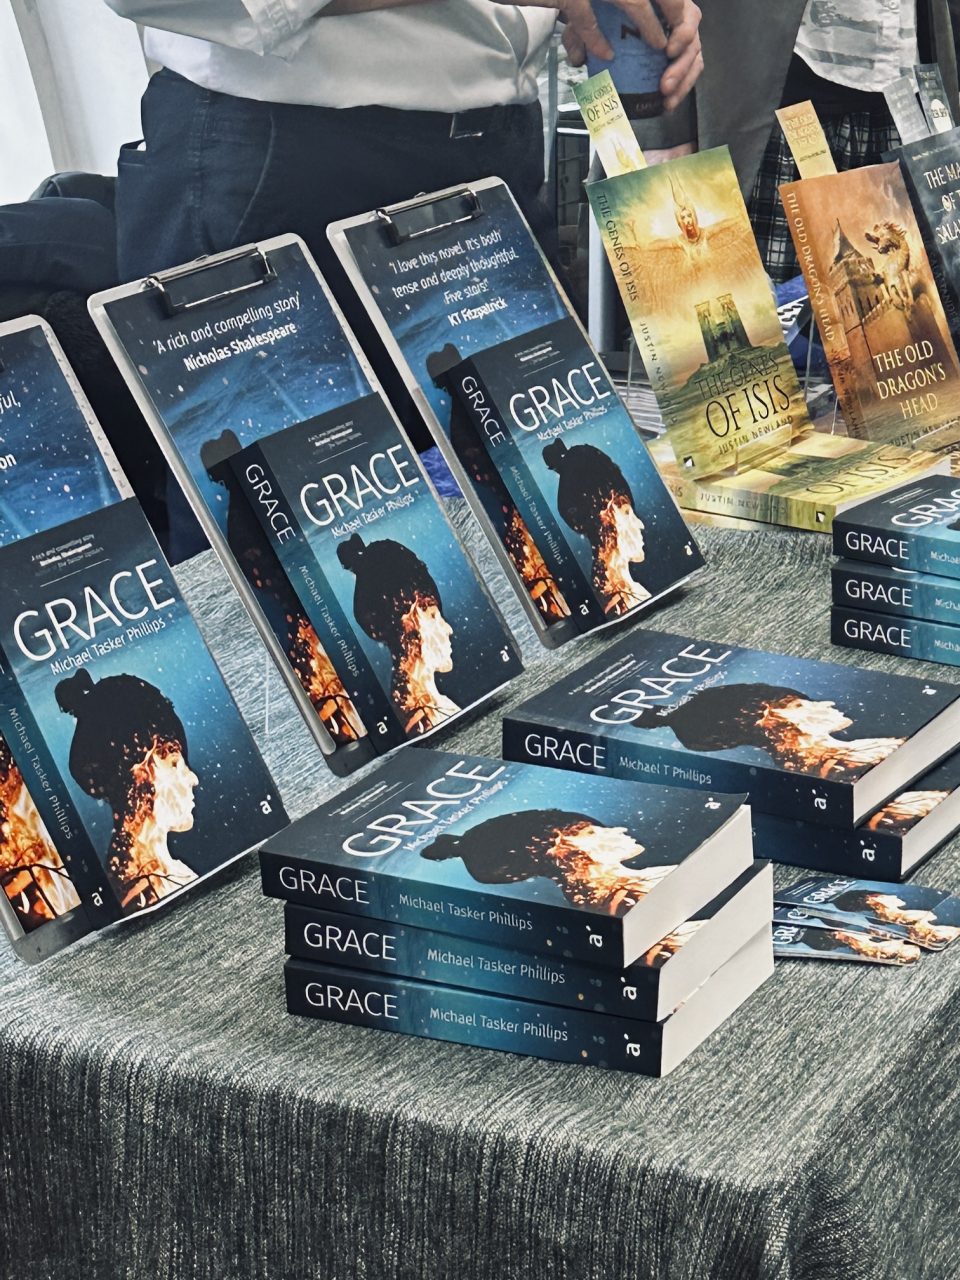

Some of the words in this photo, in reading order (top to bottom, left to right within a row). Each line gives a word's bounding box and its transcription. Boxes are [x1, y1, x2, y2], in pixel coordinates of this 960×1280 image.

[586, 106, 601, 123] OF
[601, 96, 620, 115] ISIS
[923, 170, 947, 190] THE
[596, 191, 607, 219] THE
[786, 190, 799, 218] THE
[793, 216, 808, 244] OLD
[398, 257, 419, 273] love
[418, 250, 439, 267] this
[479, 228, 502, 247] both
[604, 218, 626, 262] GENES
[391, 281, 420, 299] tense
[419, 270, 440, 290] and
[439, 262, 470, 284] deeply
[619, 261, 633, 280] OF
[625, 278, 640, 303] ISIS
[166, 331, 191, 352] rich
[189, 322, 214, 344] and
[212, 304, 275, 335] compelling
[447, 310, 462, 327] KT
[182, 345, 233, 372] Nicholas
[228, 321, 299, 356] Shakespeare
[872, 348, 905, 373] THE
[903, 339, 934, 364] OLD
[508, 361, 612, 433] GRACE
[694, 372, 731, 401] THE
[729, 351, 780, 388] GENES
[875, 361, 947, 401] DRAGON'S
[460, 374, 508, 448] GRACE
[705, 392, 742, 438] OF
[741, 374, 791, 424] ISIS
[899, 392, 939, 421] HEAD
[718, 433, 751, 456] JUSTIN
[299, 443, 421, 528] GRACE
[245, 462, 298, 546] GRACE
[297, 564, 323, 607] Michael
[844, 530, 911, 561] GRACE
[13, 557, 177, 662] GRACE
[844, 578, 915, 609] GRACE
[49, 647, 95, 677] Michael
[90, 633, 127, 659] Tasker
[125, 614, 167, 643] Phillips
[843, 618, 913, 649] GRACE
[589, 642, 733, 726] GRACE
[8, 706, 33, 758] Michael
[31, 754, 53, 794] Tasker
[48, 794, 74, 841] Phillips
[523, 732, 608, 771] GRACE
[617, 754, 661, 776] Michael
[662, 764, 670, 776] T
[671, 765, 714, 786] Phillips
[341, 759, 507, 859] GRACE
[278, 865, 372, 906] GRACE
[398, 892, 445, 914] Michael
[447, 902, 486, 923] Tasker
[488, 910, 533, 932] Phillips
[302, 921, 398, 962] GRACE
[426, 947, 475, 969] Michael
[476, 955, 516, 976] Tasker
[519, 963, 566, 986] Phillips
[304, 981, 400, 1021] GRACE
[428, 1006, 478, 1028] Michael
[479, 1014, 520, 1035] Tasker
[522, 1021, 569, 1043] Phillips
